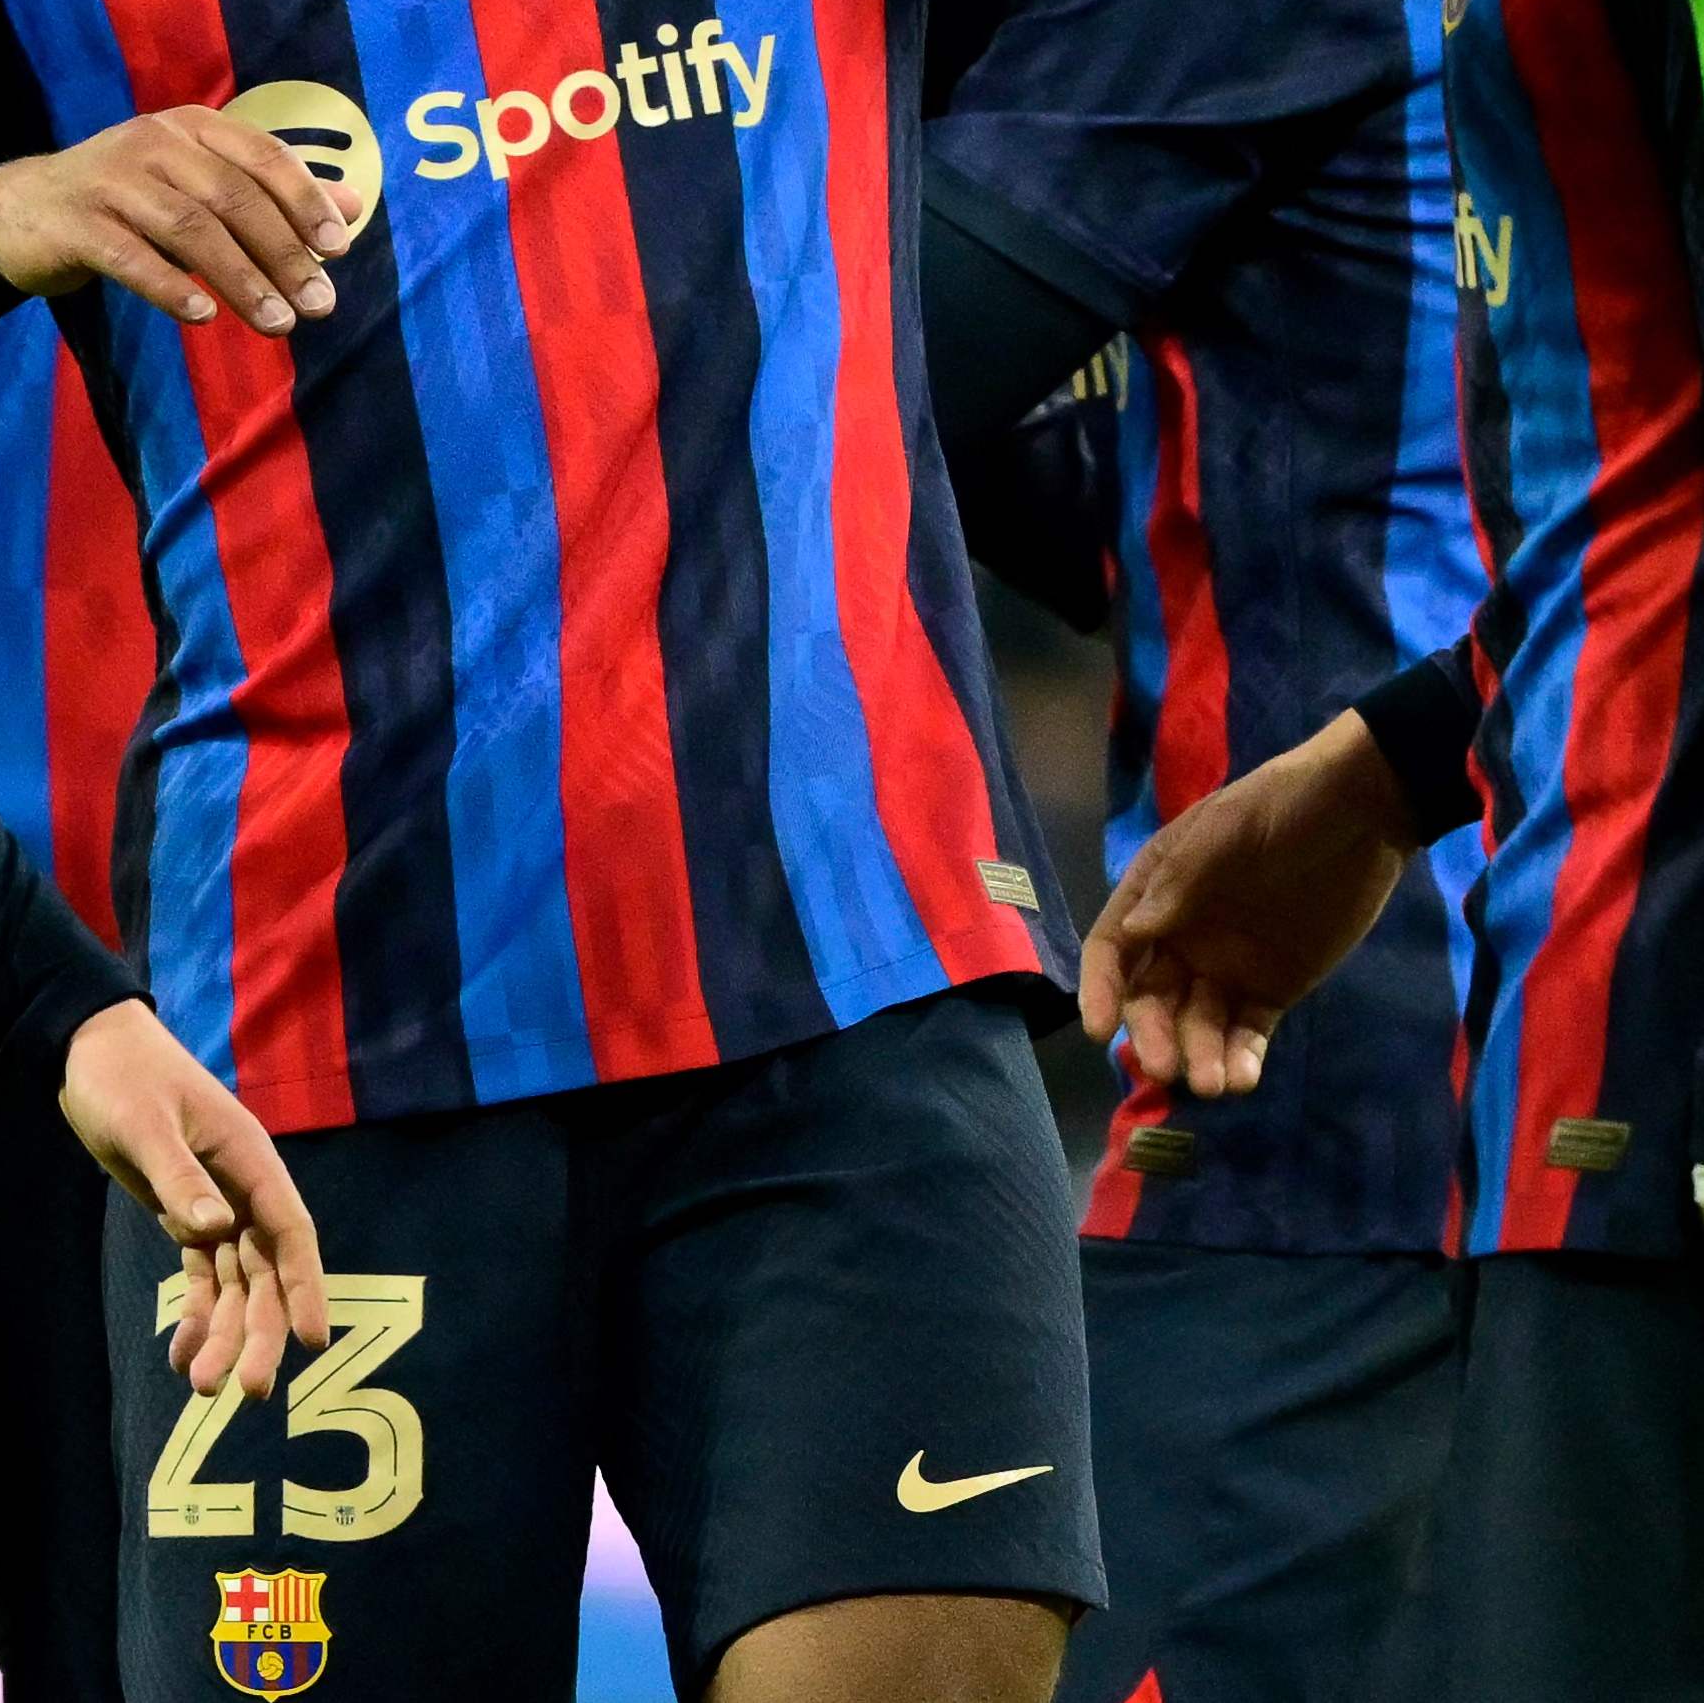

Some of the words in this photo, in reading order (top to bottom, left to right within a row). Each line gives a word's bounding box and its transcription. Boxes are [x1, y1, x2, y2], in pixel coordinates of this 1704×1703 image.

[404, 18, 776, 182] Spotify
[147, 1272, 428, 1543] 23
[247, 1624, 292, 1640] FCB
